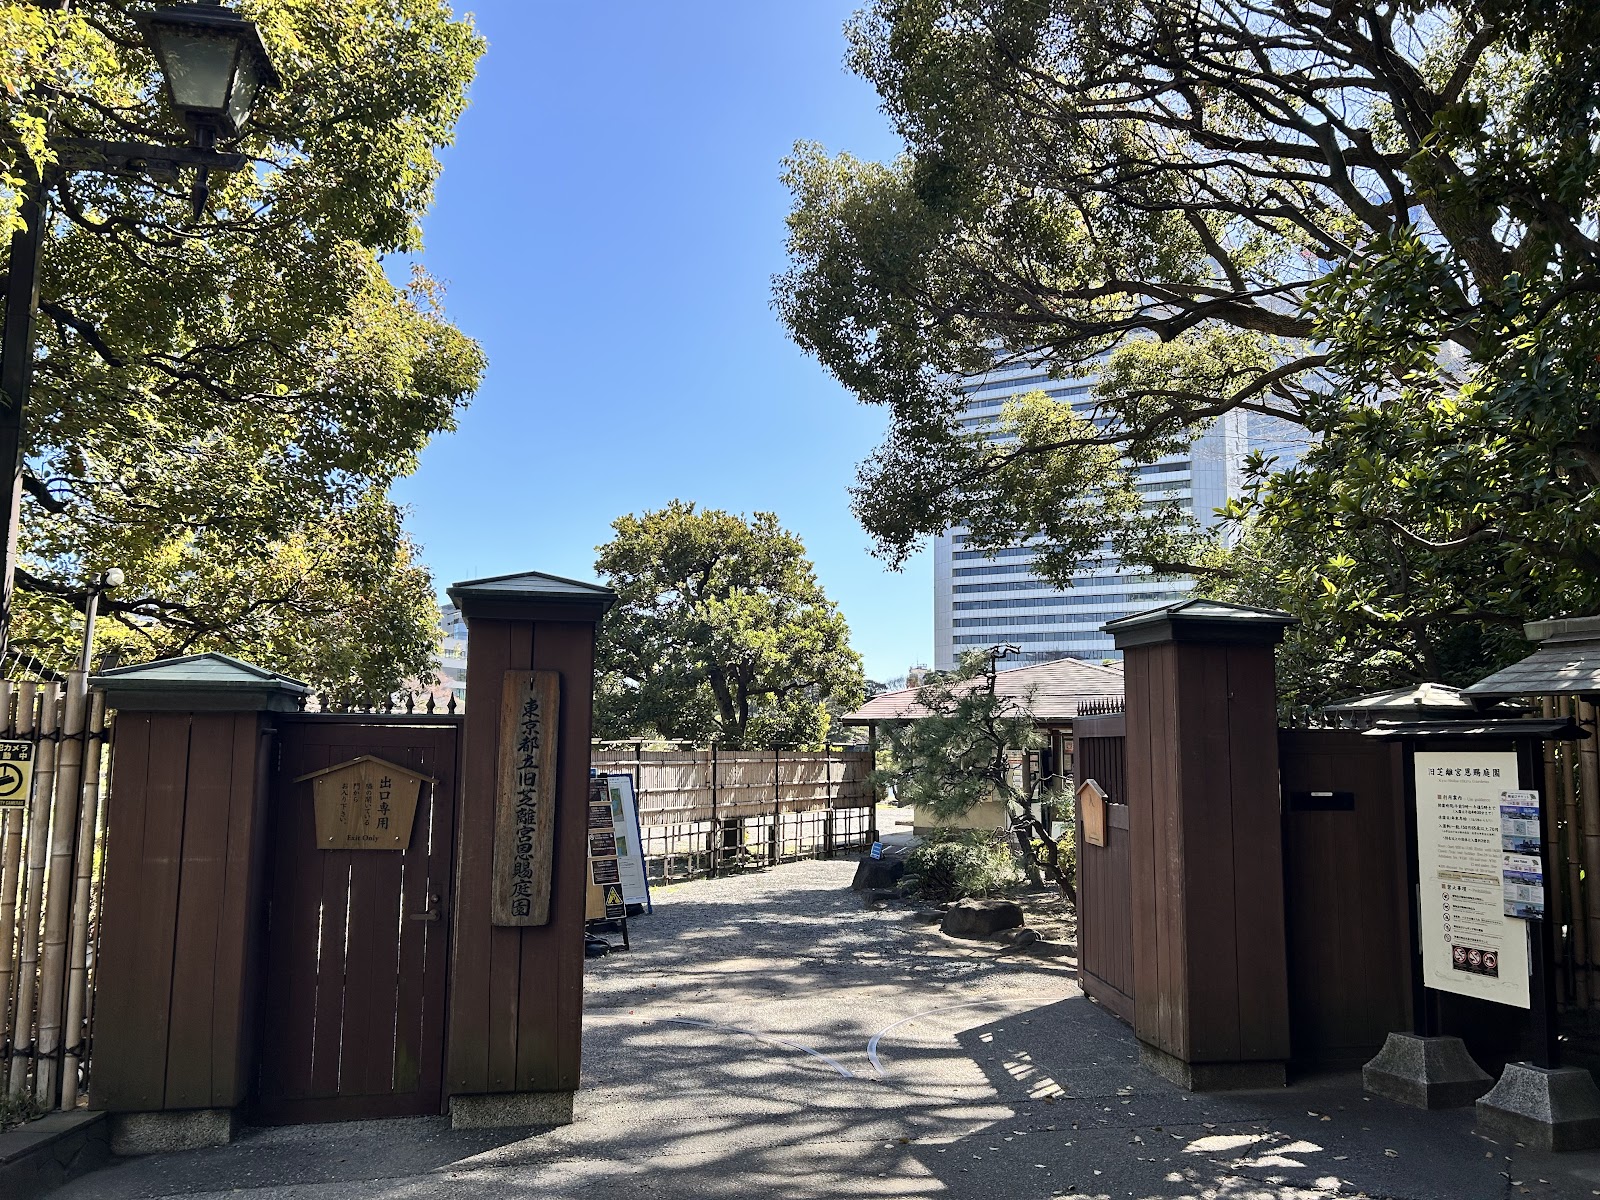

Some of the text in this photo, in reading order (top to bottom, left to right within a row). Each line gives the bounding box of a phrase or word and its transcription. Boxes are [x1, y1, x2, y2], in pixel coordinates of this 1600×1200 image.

[376, 776, 392, 830] 出口専用
[510, 698, 540, 917] 東京都立旧芝離宮恩賜庭園
[362, 834, 379, 843] Only
